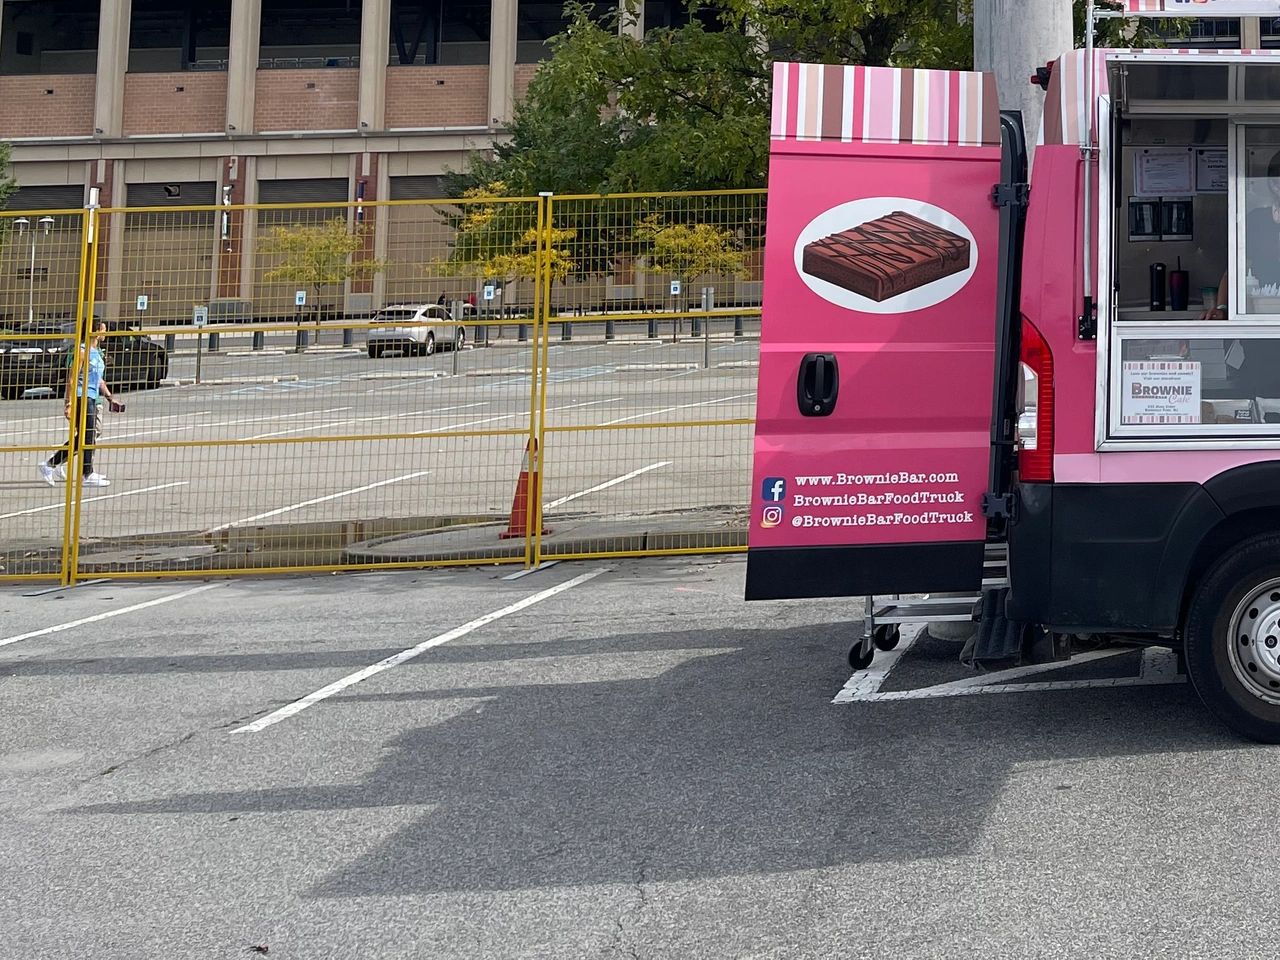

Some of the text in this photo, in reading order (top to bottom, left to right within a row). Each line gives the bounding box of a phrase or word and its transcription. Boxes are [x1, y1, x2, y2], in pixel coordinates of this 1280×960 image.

[1132, 382, 1193, 395] BROWNIE
[795, 471, 959, 487] www.BrownieBar.com
[793, 491, 965, 507] BrownieBarFoodTruck
[792, 511, 974, 528] @BrownieBarFoodTruck
